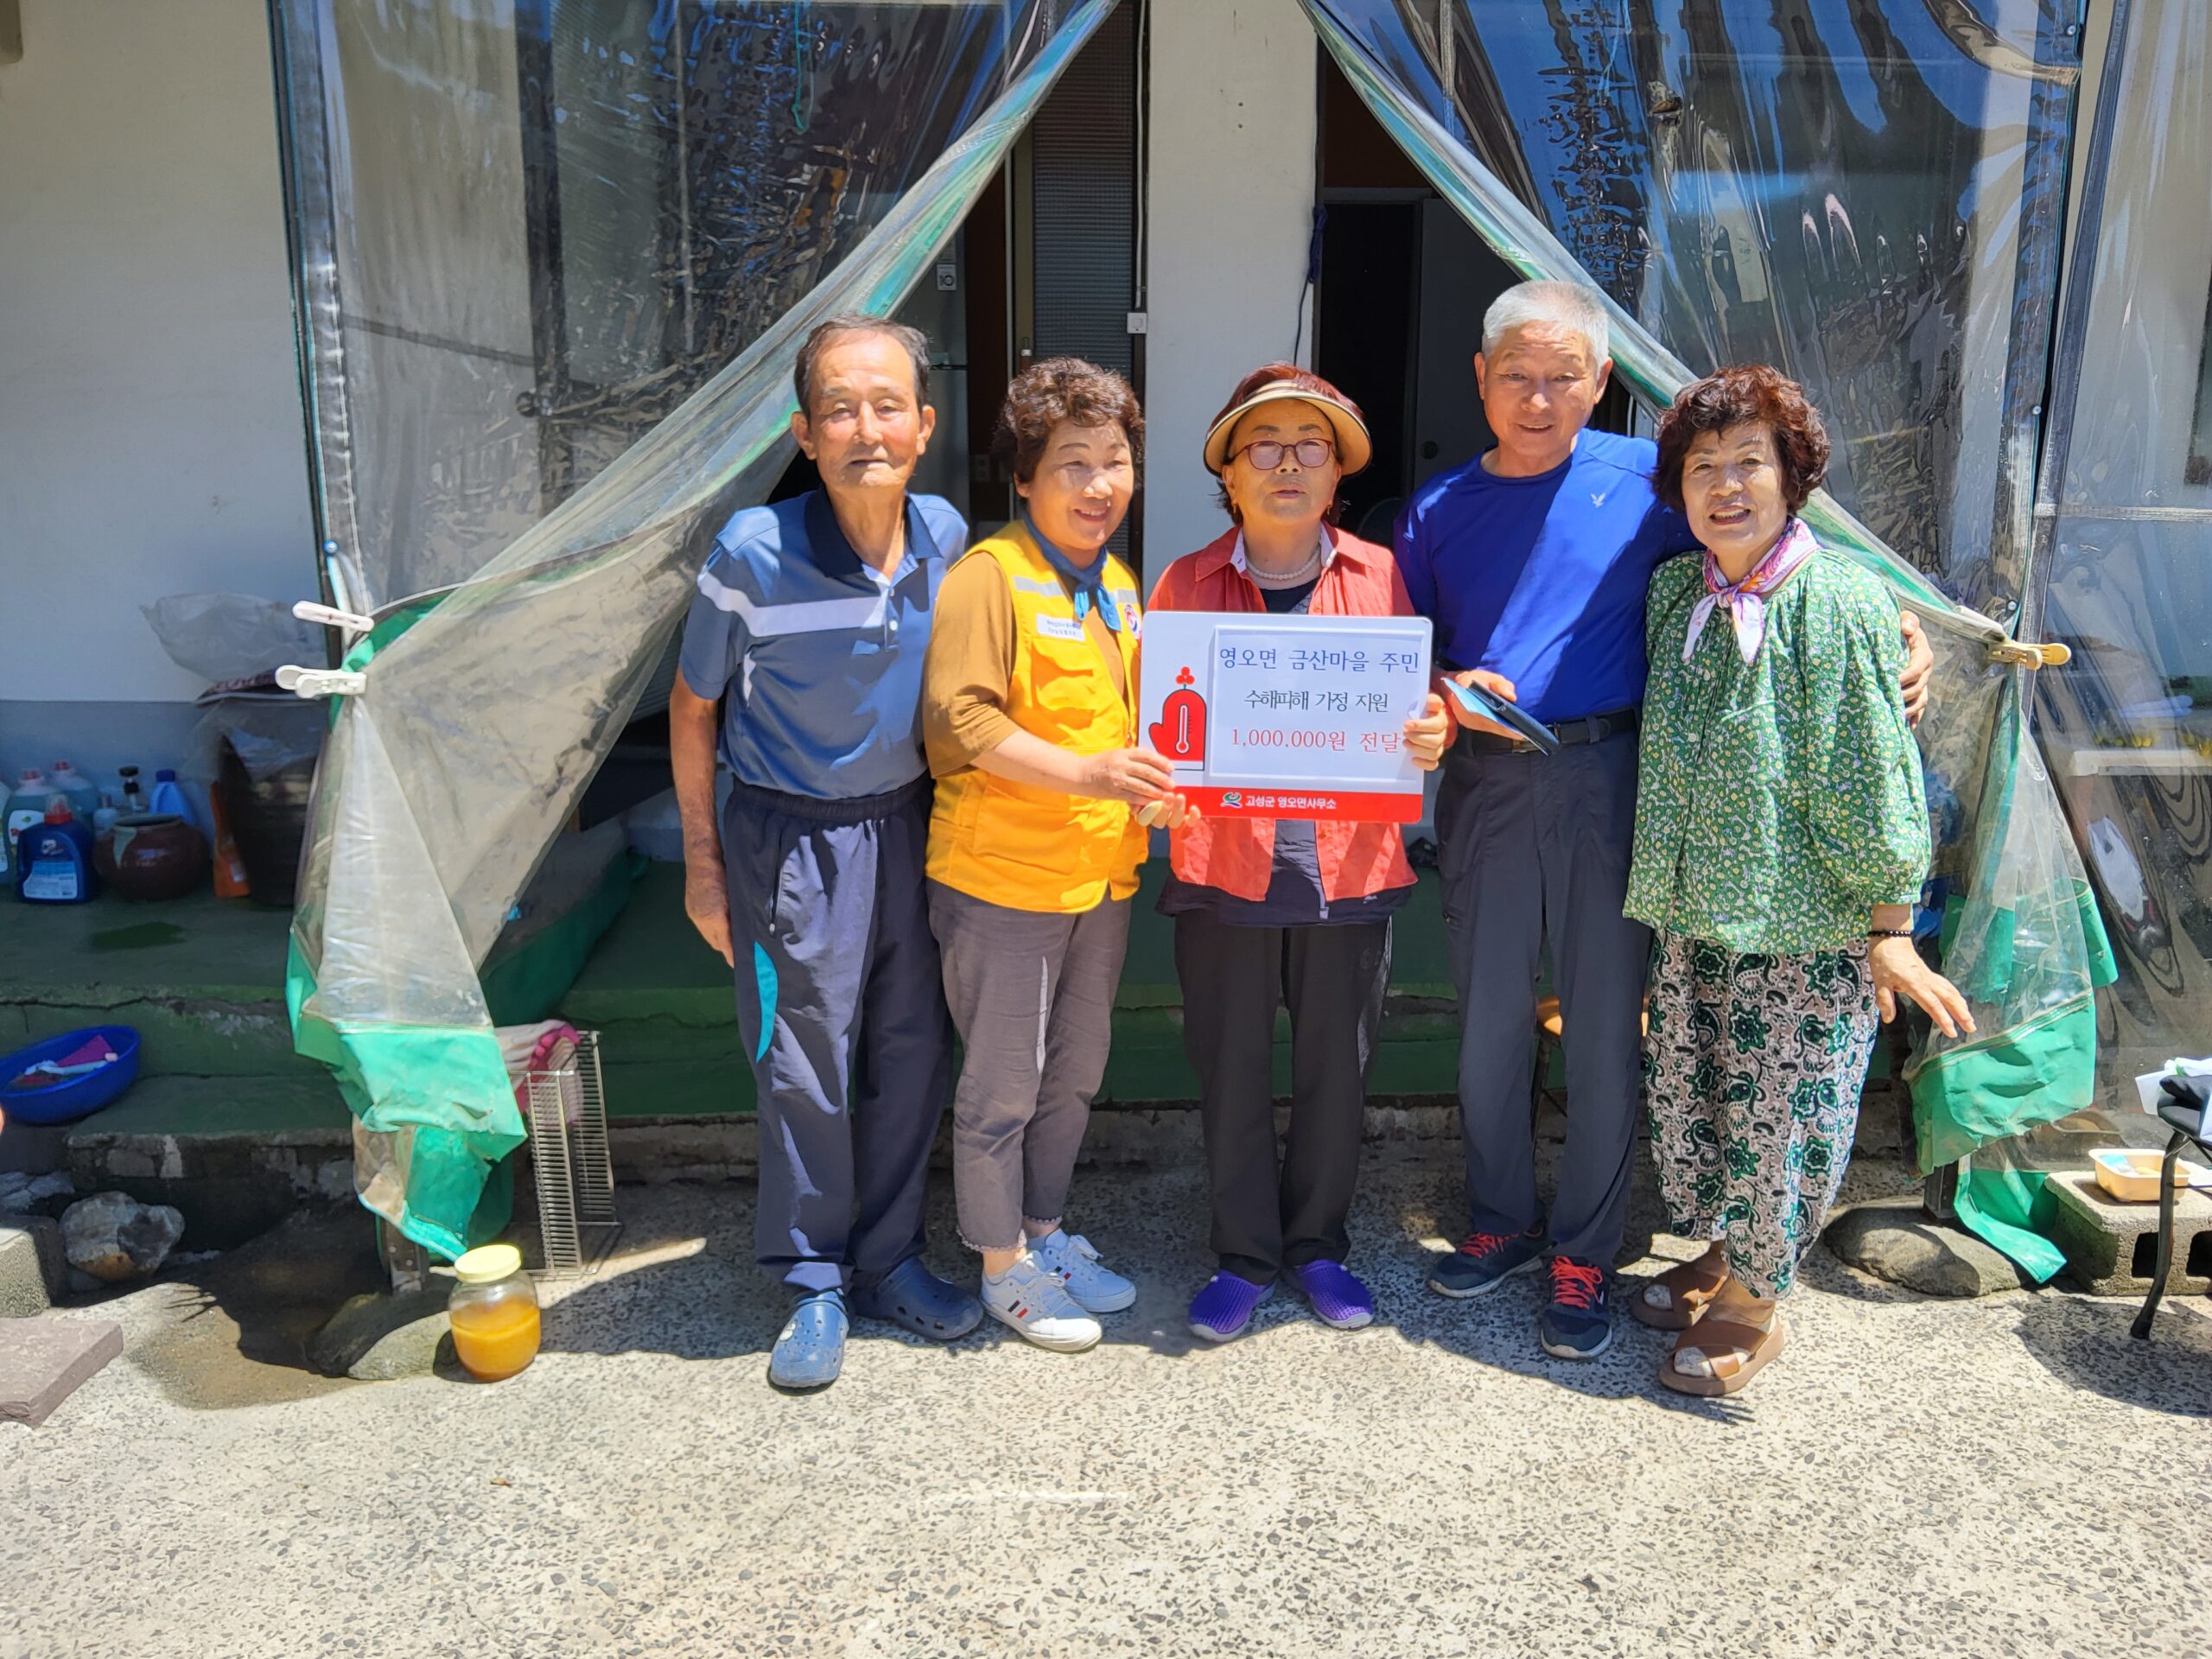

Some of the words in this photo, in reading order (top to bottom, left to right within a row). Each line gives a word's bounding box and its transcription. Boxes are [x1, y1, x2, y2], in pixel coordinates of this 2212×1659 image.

[1219, 647, 1276, 670] 영오면
[1287, 650, 1370, 672] 금산마을
[1379, 652, 1419, 674] 주민
[1243, 690, 1310, 710] 수해피해
[1315, 691, 1348, 712] 가정
[1355, 693, 1389, 713] 지원
[1360, 732, 1402, 753] 전달
[1245, 795, 1275, 808] 고성군
[1277, 796, 1337, 810] 영오면사무소
